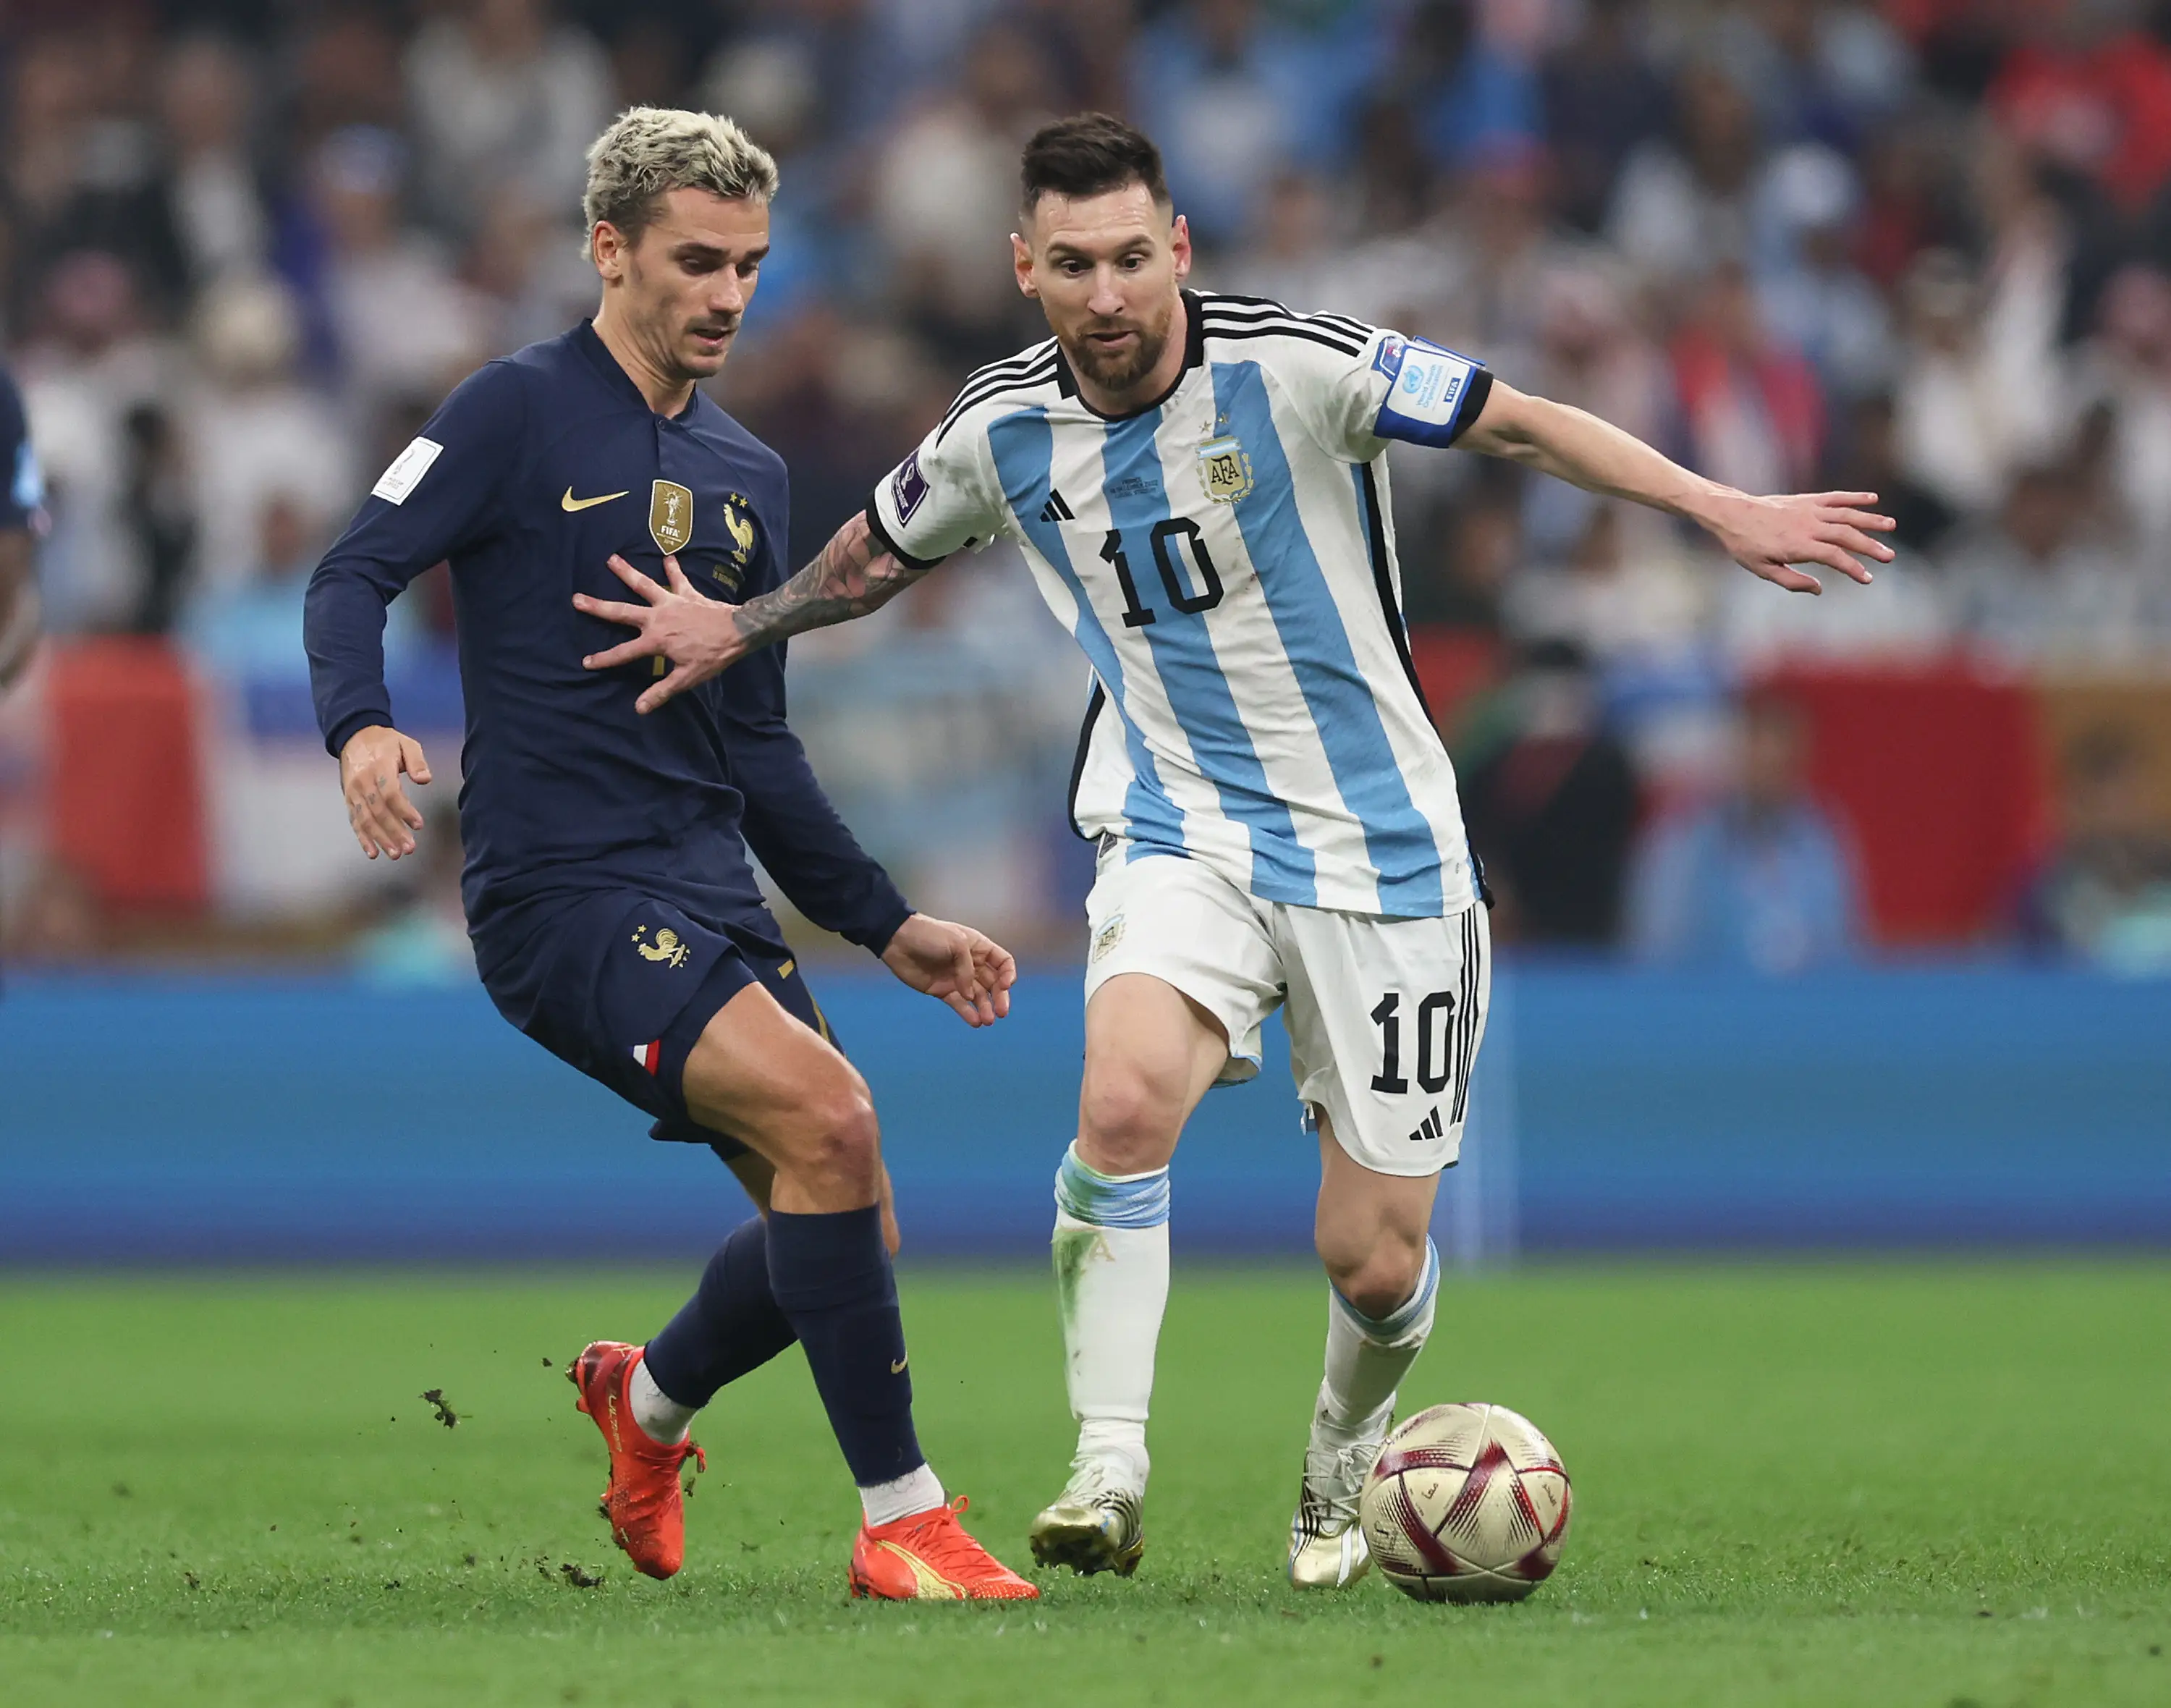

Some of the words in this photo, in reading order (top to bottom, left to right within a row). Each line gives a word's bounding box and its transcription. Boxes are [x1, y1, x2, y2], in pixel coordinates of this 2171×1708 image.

[1445, 381, 1458, 399] FIFA
[1211, 455, 1240, 485] AFA
[661, 525, 679, 538] FIFA
[1099, 517, 1224, 627] 10
[1370, 991, 1456, 1094] 10
